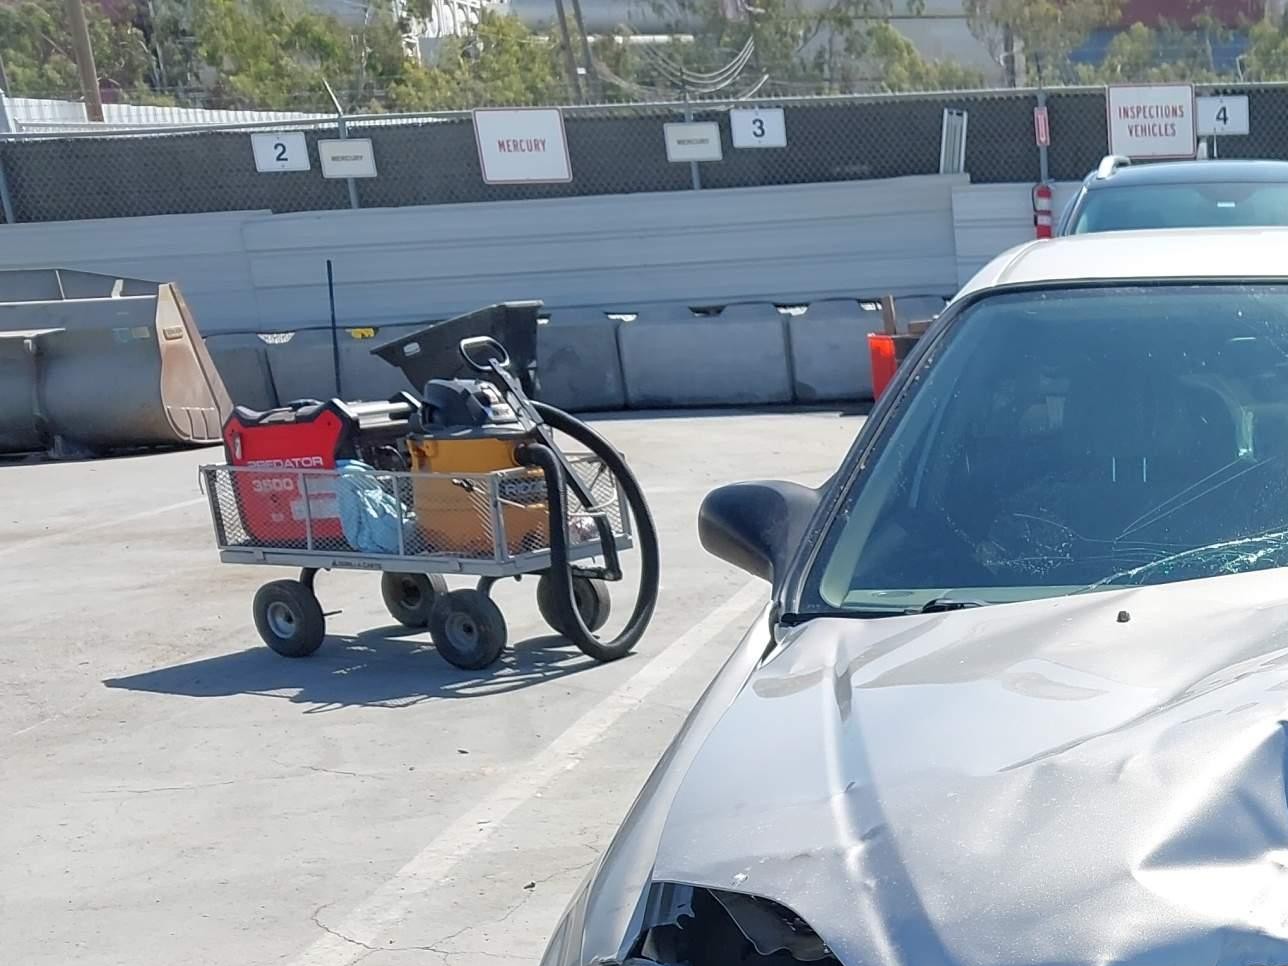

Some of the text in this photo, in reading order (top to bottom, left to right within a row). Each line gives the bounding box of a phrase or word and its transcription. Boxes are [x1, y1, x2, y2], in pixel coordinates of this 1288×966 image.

[1118, 104, 1185, 120] INSPECTIONS
[1215, 106, 1229, 126] 4
[752, 118, 765, 138] 3
[1127, 123, 1177, 138] VEHICLES
[274, 143, 289, 162] 2
[497, 138, 546, 153] MERCURY
